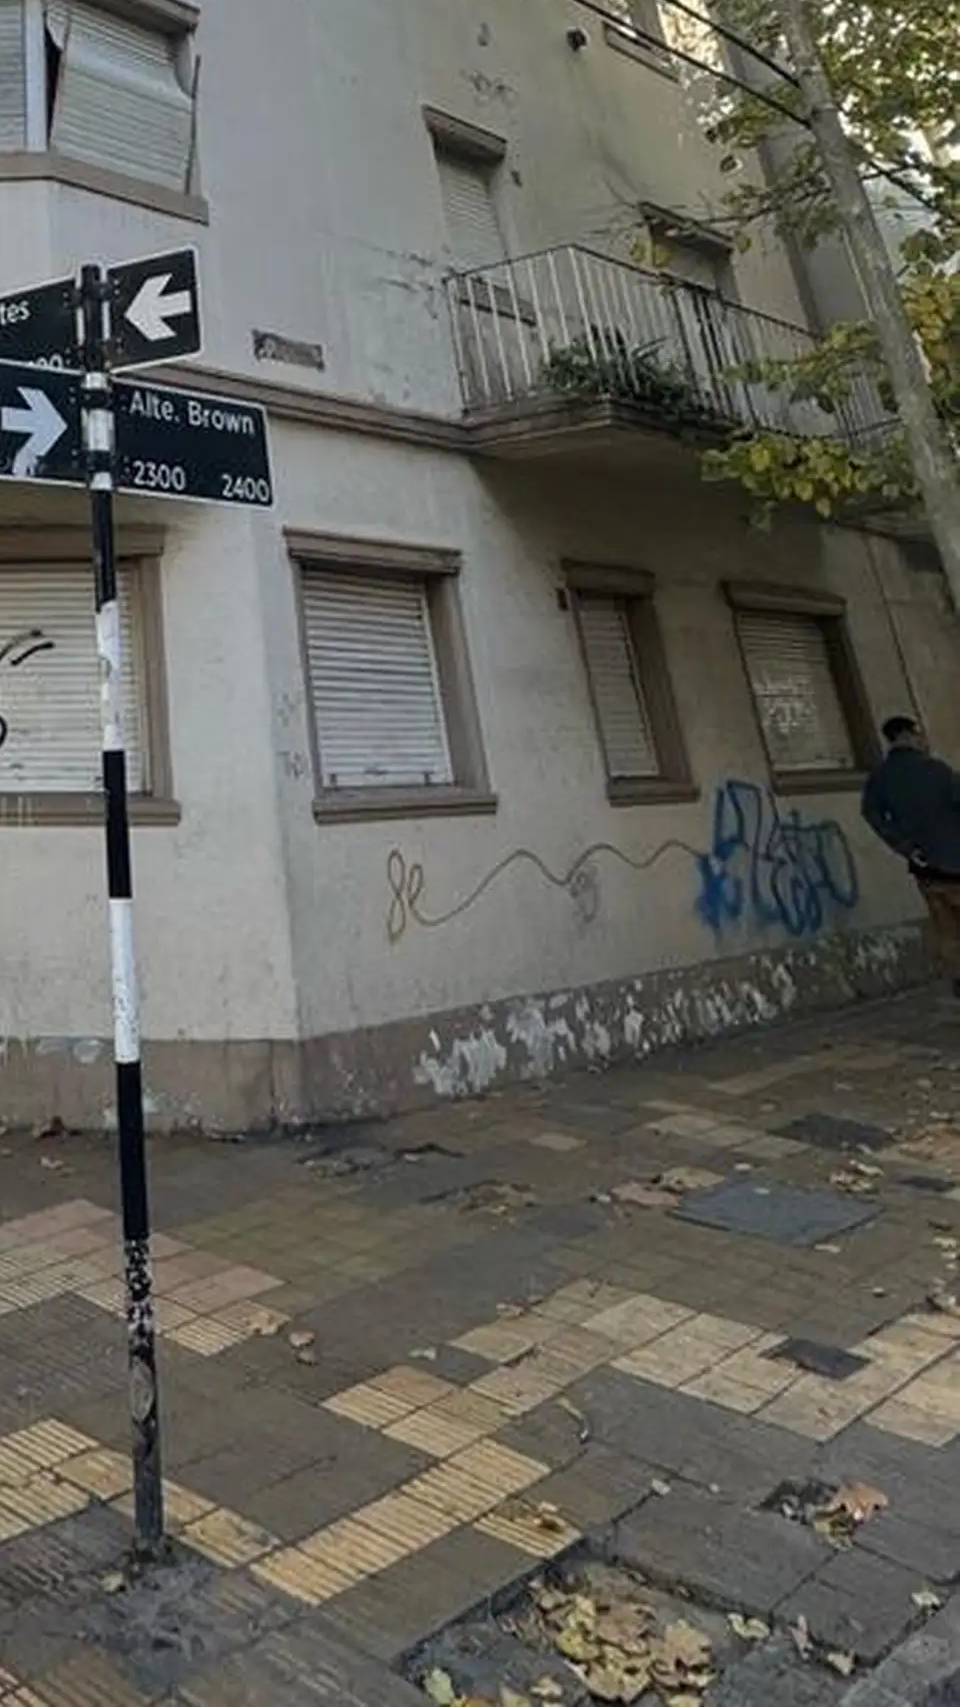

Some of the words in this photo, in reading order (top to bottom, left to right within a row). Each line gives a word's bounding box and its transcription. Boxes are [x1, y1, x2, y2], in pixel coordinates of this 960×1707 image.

[129, 390, 180, 422] Alte.
[187, 400, 256, 437] Brown
[133, 460, 186, 491] 2300
[221, 474, 270, 502] 2400
